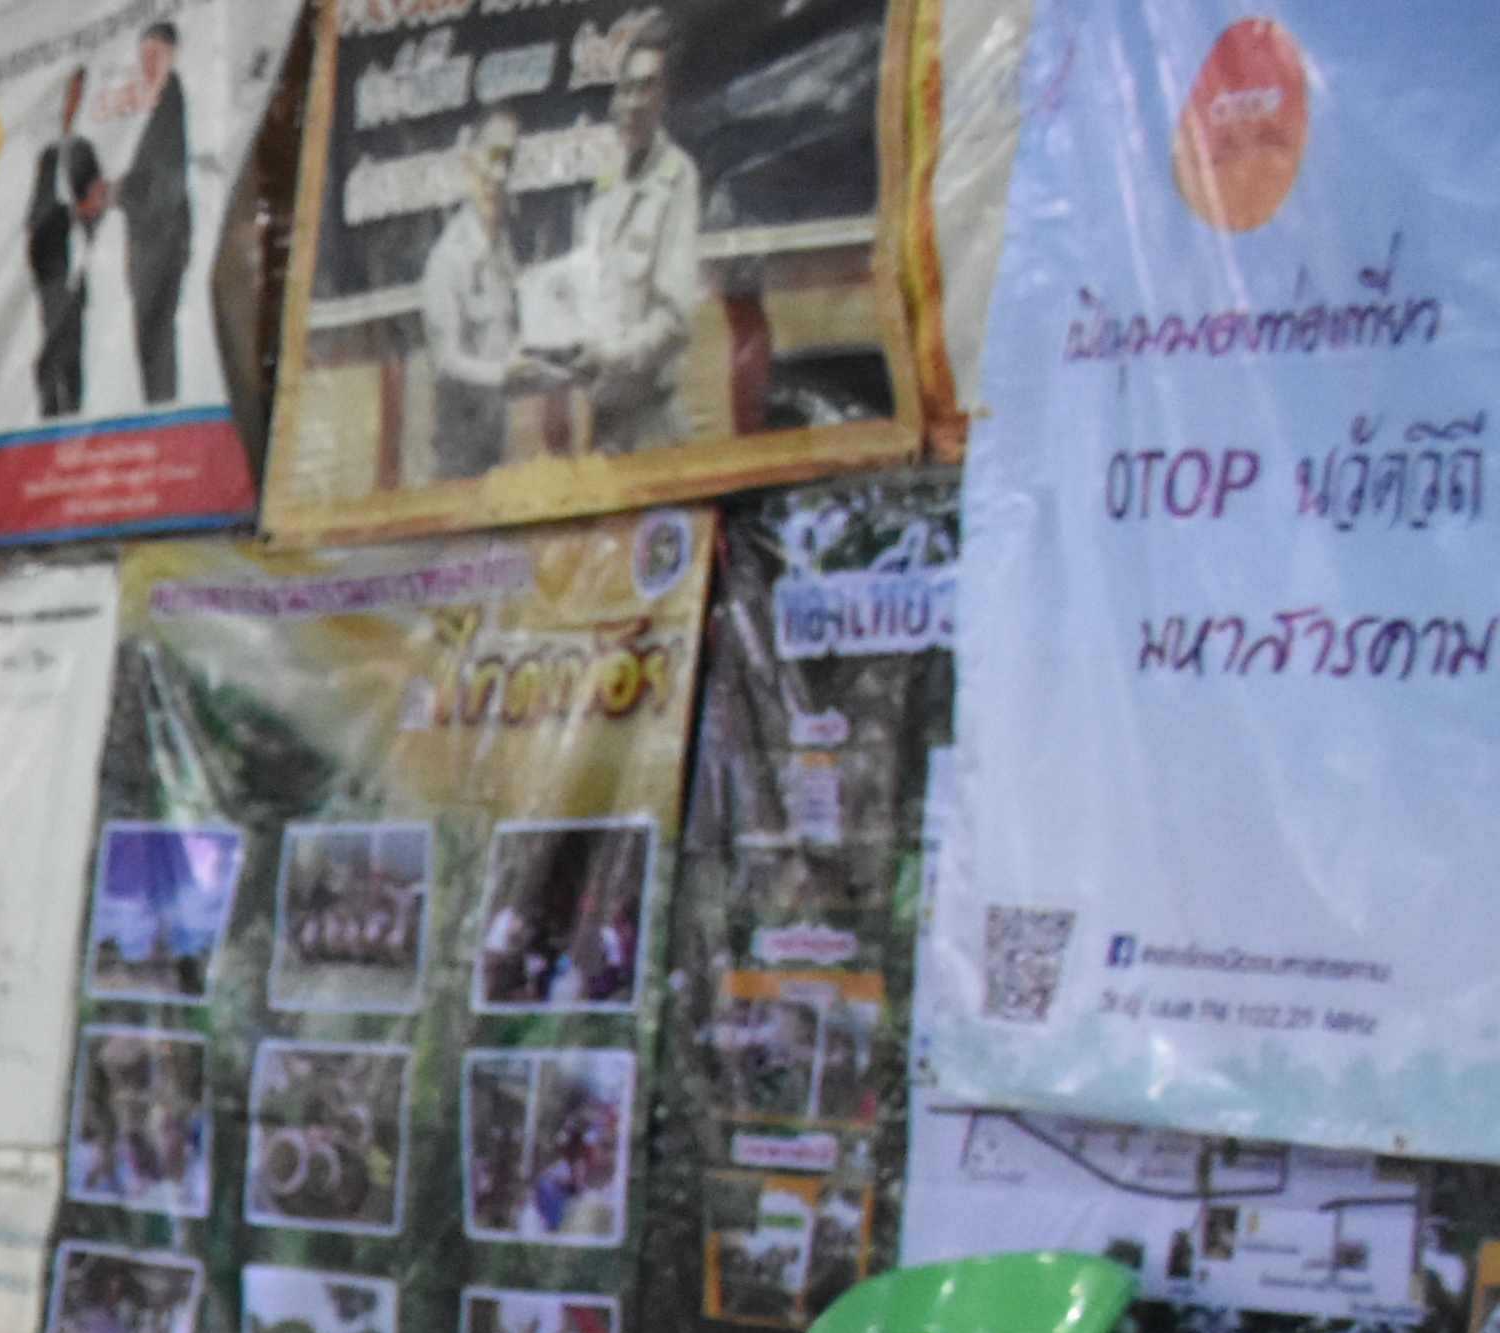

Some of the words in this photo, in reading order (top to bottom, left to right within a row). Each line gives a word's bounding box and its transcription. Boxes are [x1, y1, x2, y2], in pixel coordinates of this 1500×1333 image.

[1105, 447, 1261, 521] OTOP
[1138, 607, 1499, 680] มหาสารคาม
